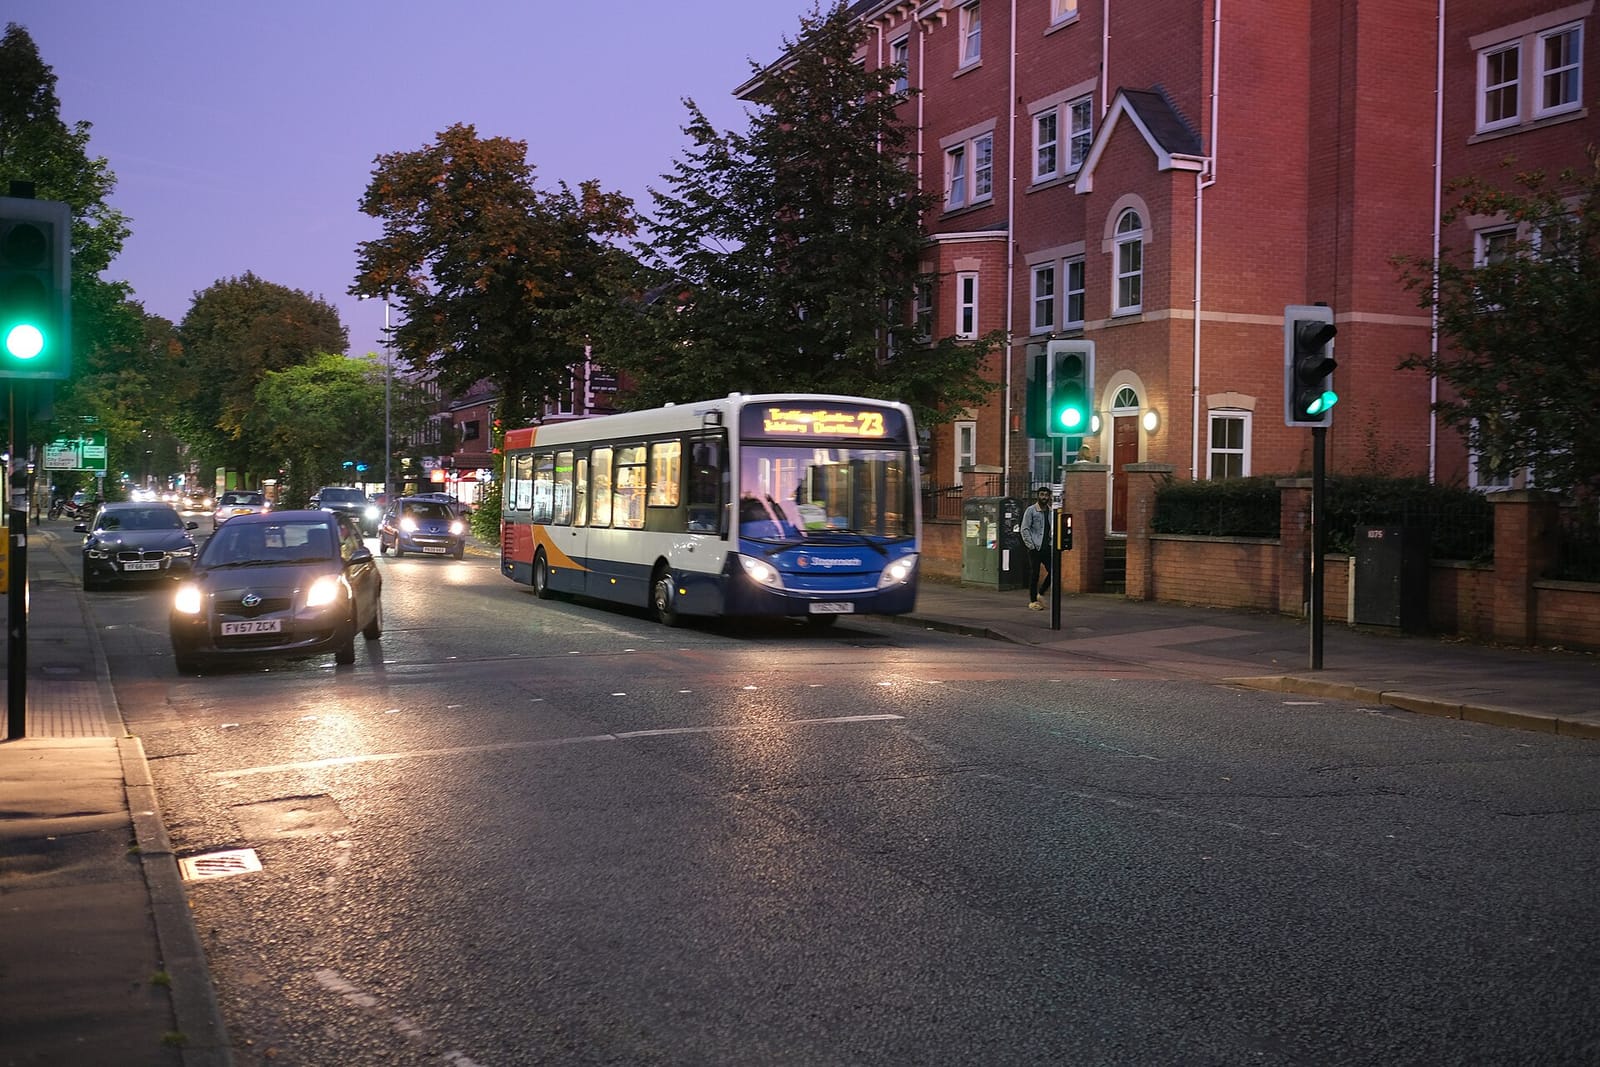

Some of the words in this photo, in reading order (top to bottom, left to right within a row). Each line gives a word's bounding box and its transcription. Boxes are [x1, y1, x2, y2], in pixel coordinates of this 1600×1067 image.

[857, 412, 884, 436] 23
[225, 622, 253, 634] FV57
[255, 621, 277, 632] ZCK
